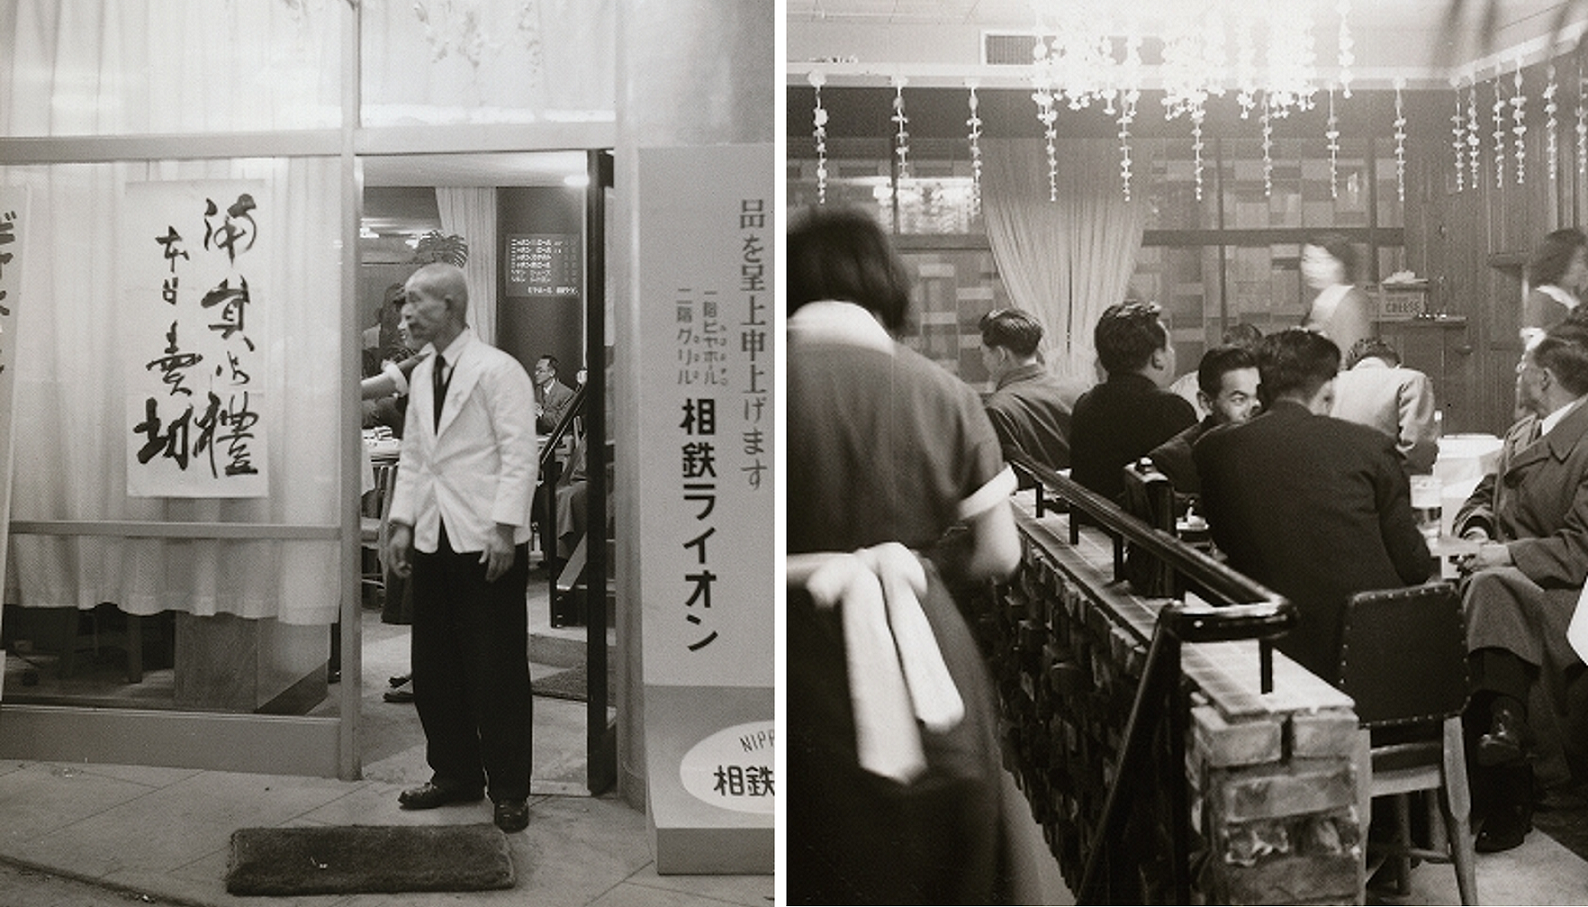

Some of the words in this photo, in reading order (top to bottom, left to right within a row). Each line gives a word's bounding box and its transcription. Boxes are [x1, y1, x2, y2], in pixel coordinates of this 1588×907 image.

[679, 398, 718, 653] 相鉄ライオン
[713, 765, 774, 797] 相鉄
